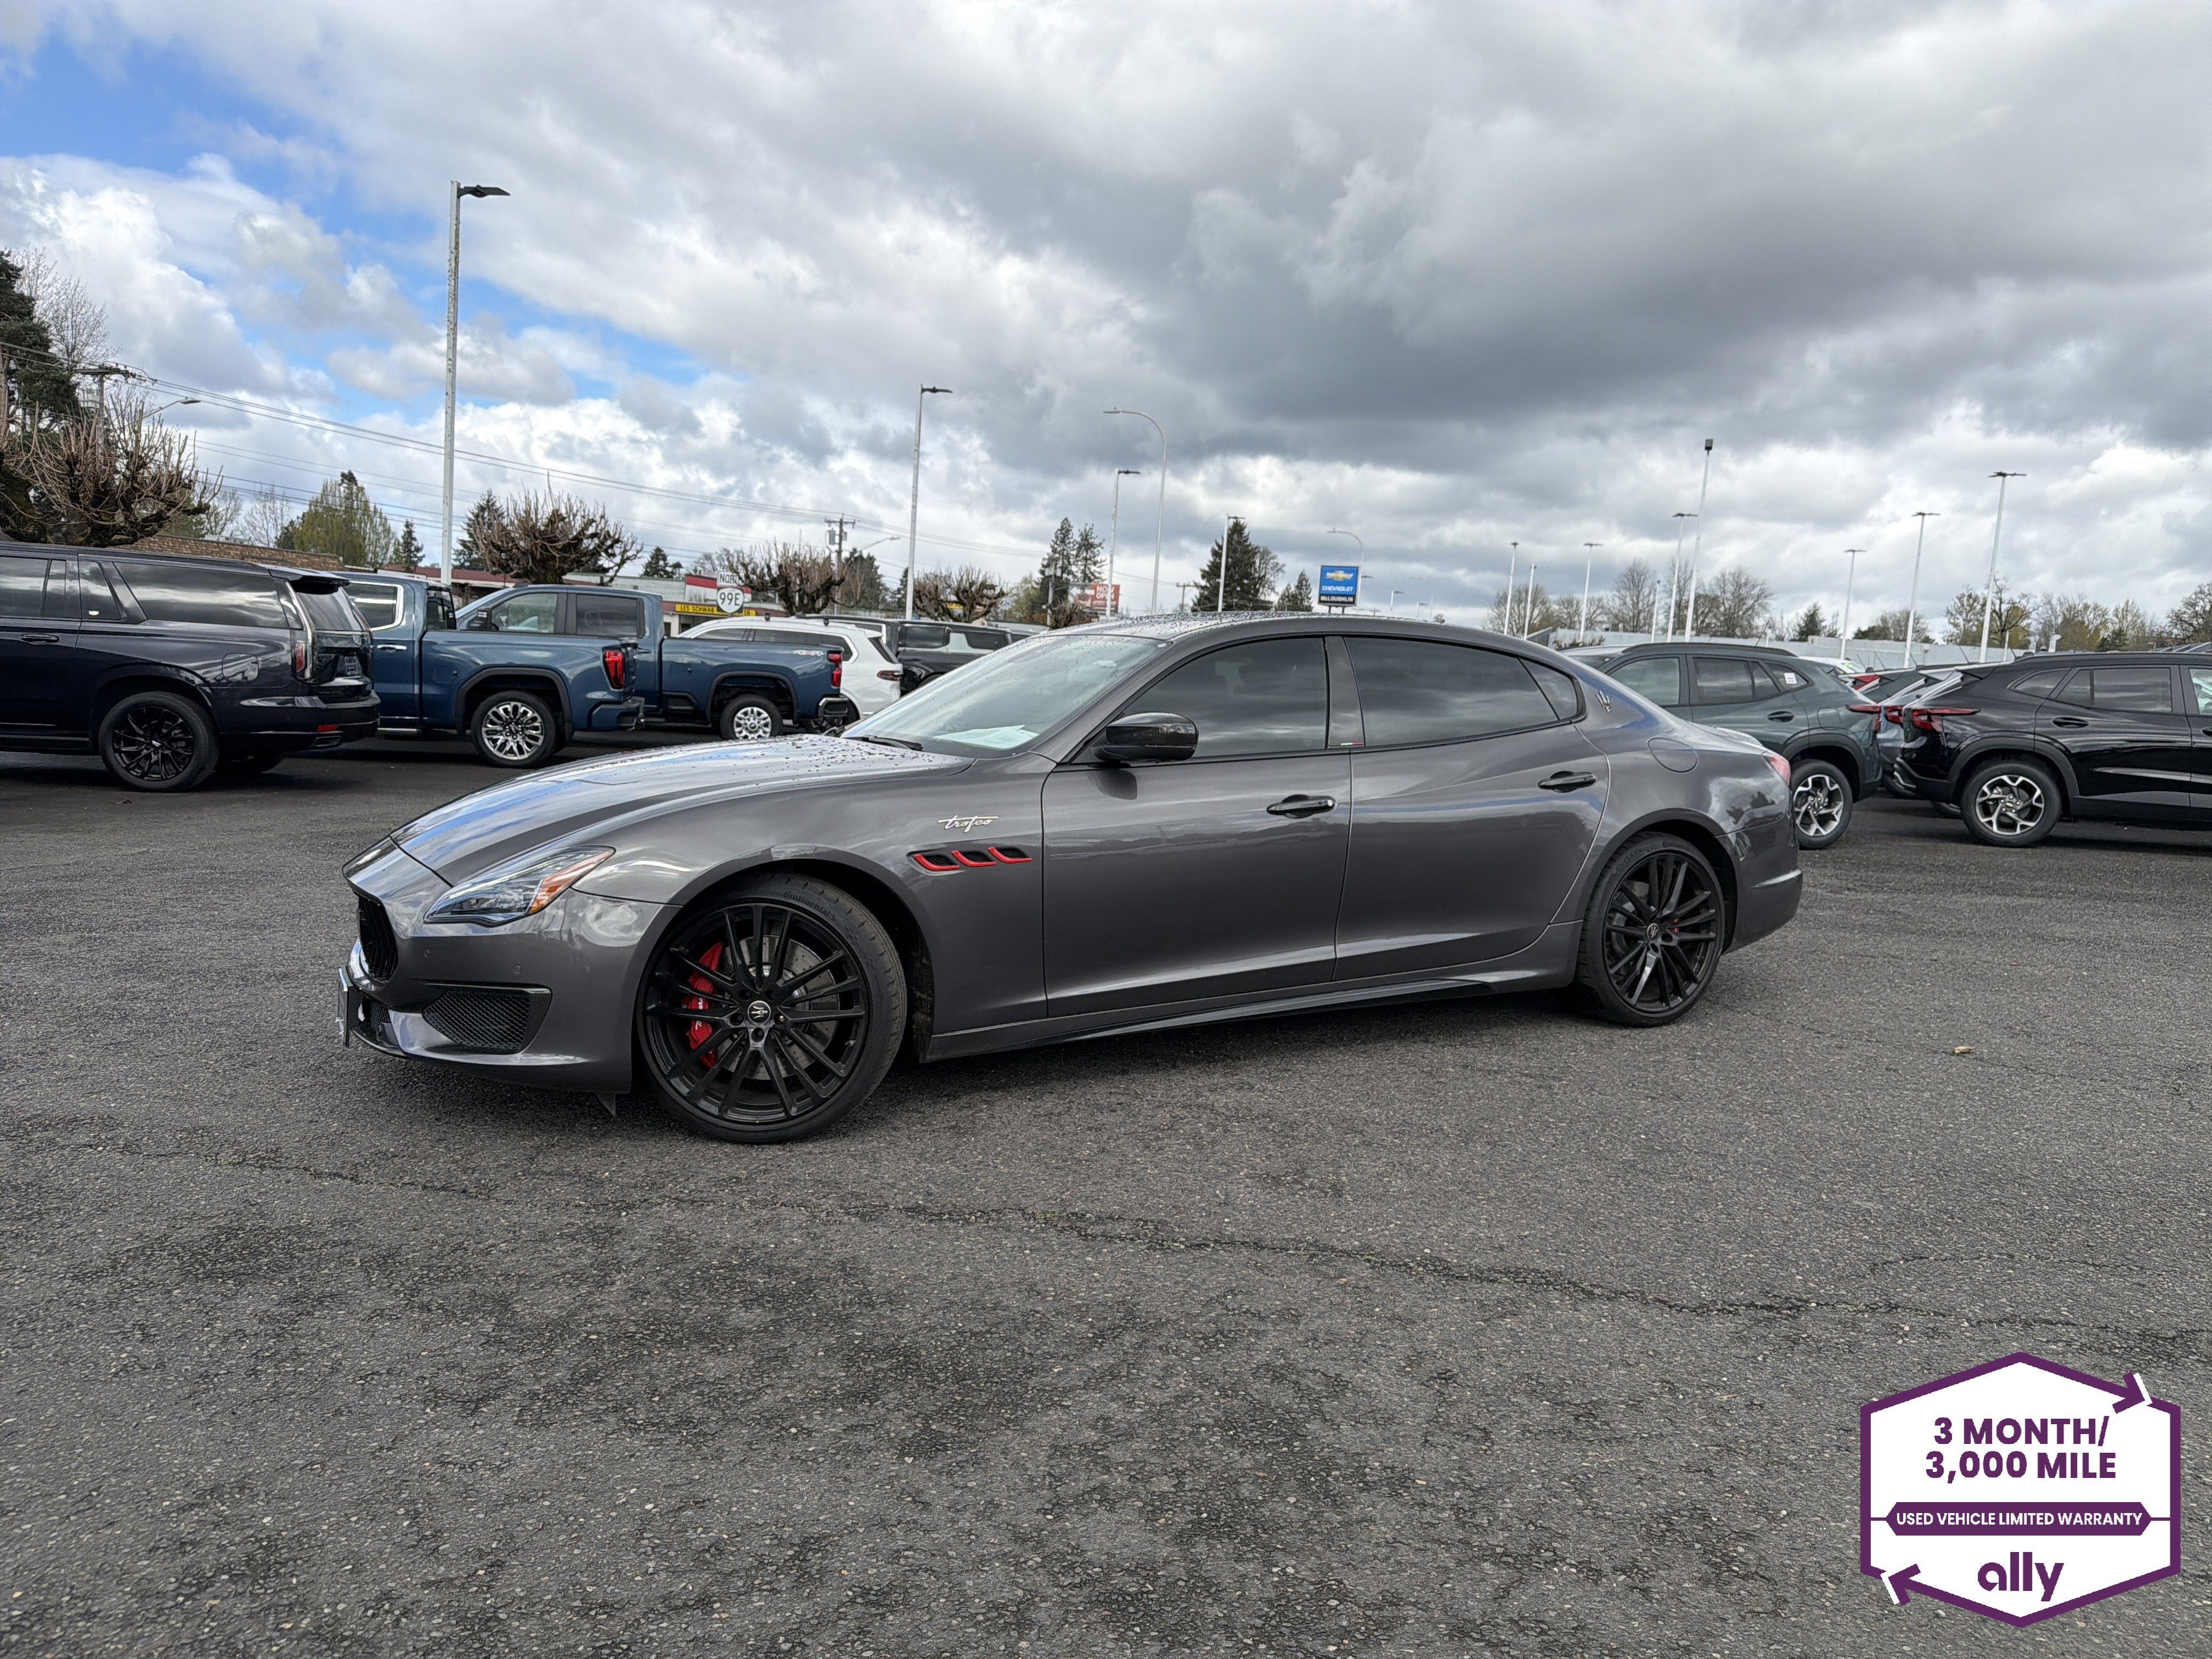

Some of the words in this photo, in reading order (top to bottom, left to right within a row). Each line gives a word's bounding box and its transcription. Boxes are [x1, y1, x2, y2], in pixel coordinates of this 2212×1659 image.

[720, 573, 738, 584] NORT
[719, 592, 741, 606] 99E
[783, 891, 831, 917] Continental
